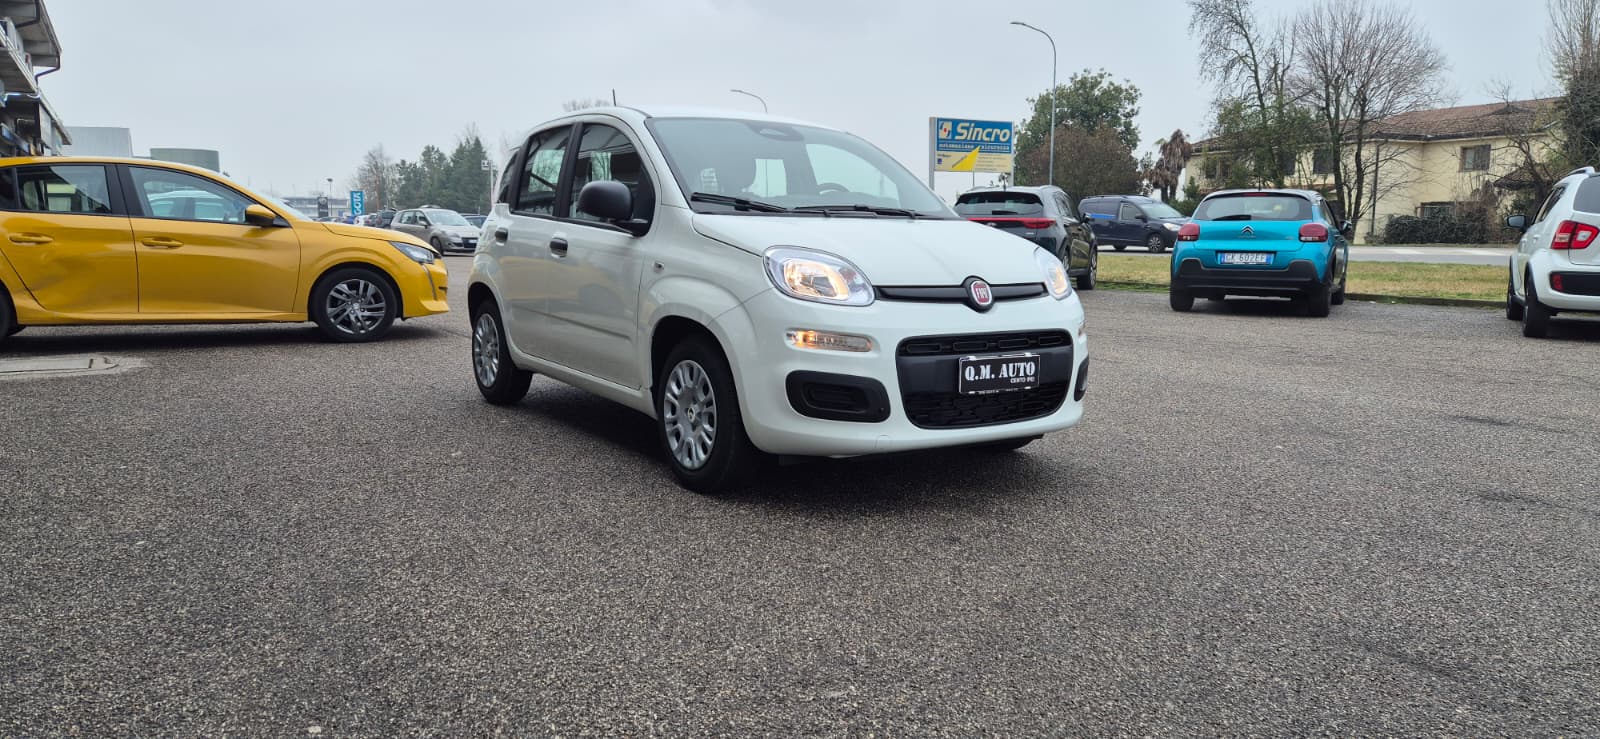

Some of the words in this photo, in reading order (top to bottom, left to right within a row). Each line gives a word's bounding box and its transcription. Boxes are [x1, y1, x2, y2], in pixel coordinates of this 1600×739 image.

[955, 122, 1010, 142] Sincro
[975, 288, 989, 299] FIAT
[964, 365, 995, 381] Q.M.
[999, 361, 1035, 378] AUTO
